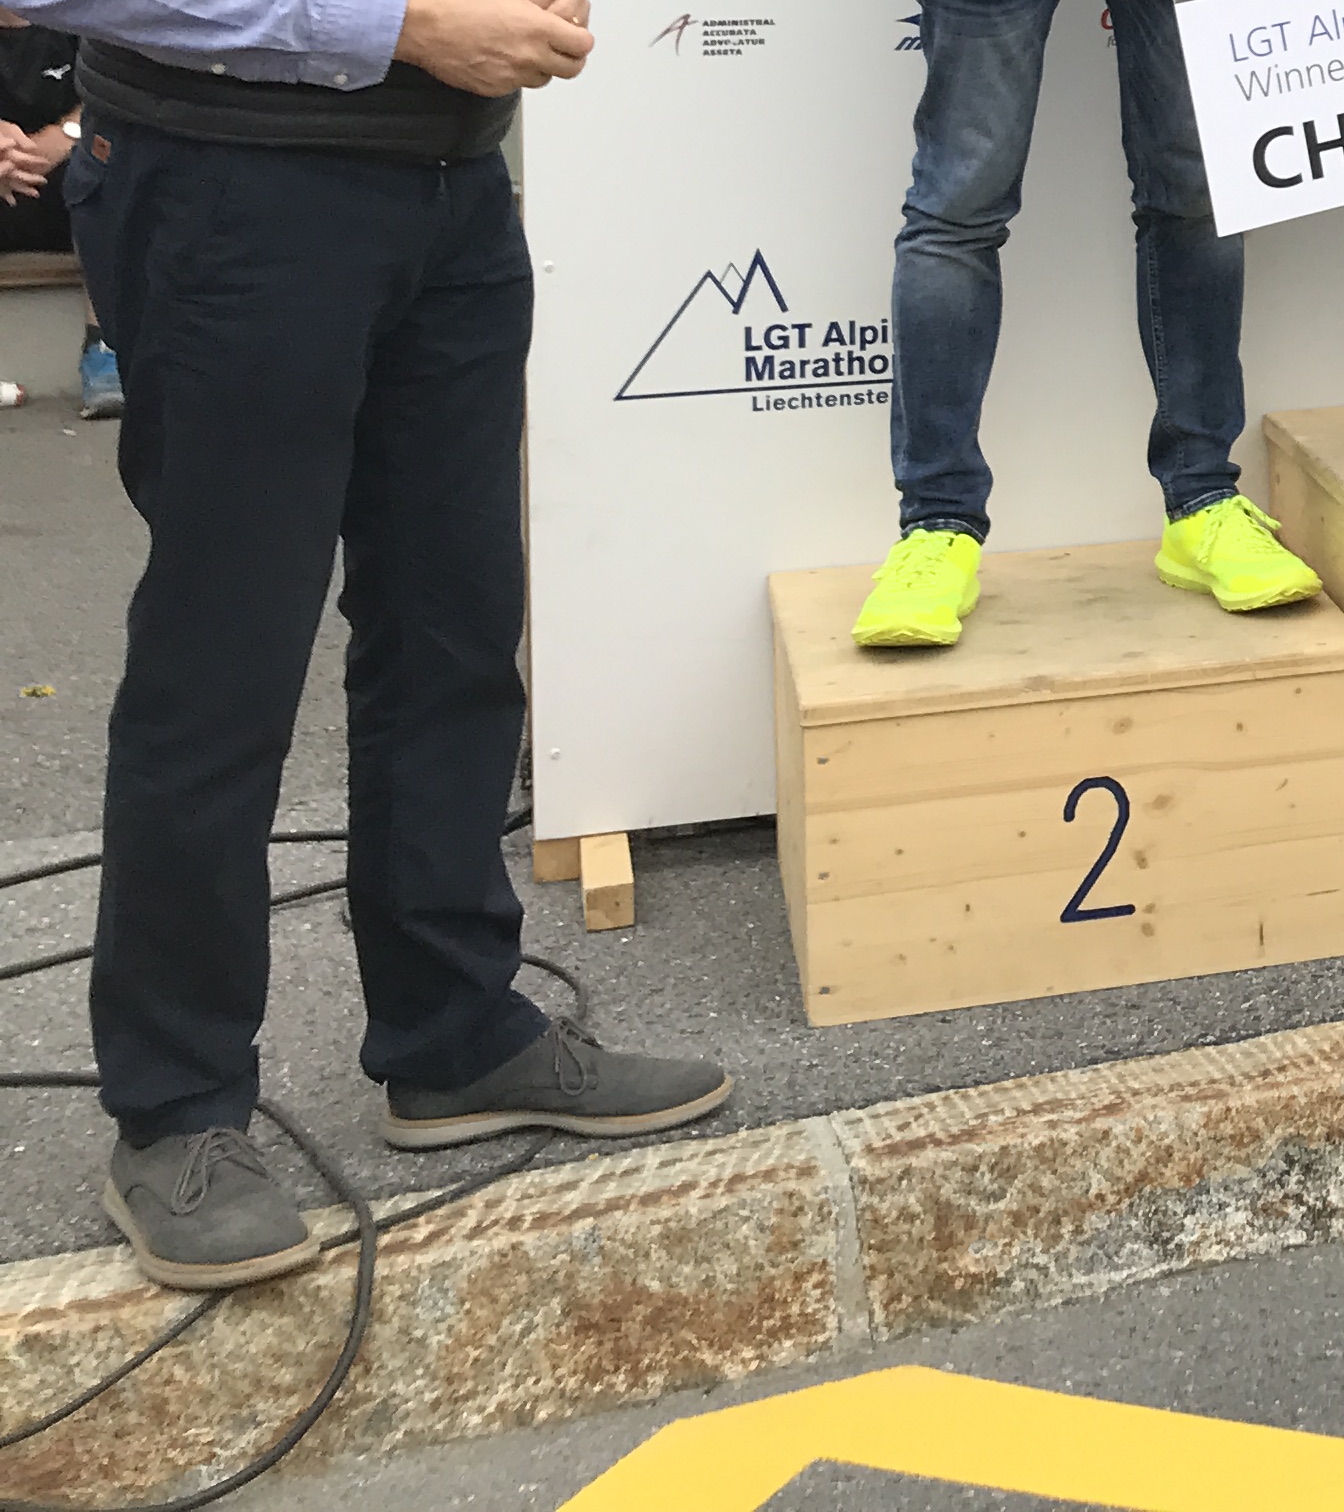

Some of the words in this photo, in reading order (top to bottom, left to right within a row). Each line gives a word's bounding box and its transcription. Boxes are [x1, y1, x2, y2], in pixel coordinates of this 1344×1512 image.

[702, 19, 776, 27] ADMINISTRAL
[1228, 21, 1292, 64] LGT
[744, 322, 813, 352] LGT
[821, 319, 890, 350] Alpi
[744, 351, 893, 383] Maratho
[752, 389, 889, 412] Liechtenste
[1061, 776, 1135, 922] 2
